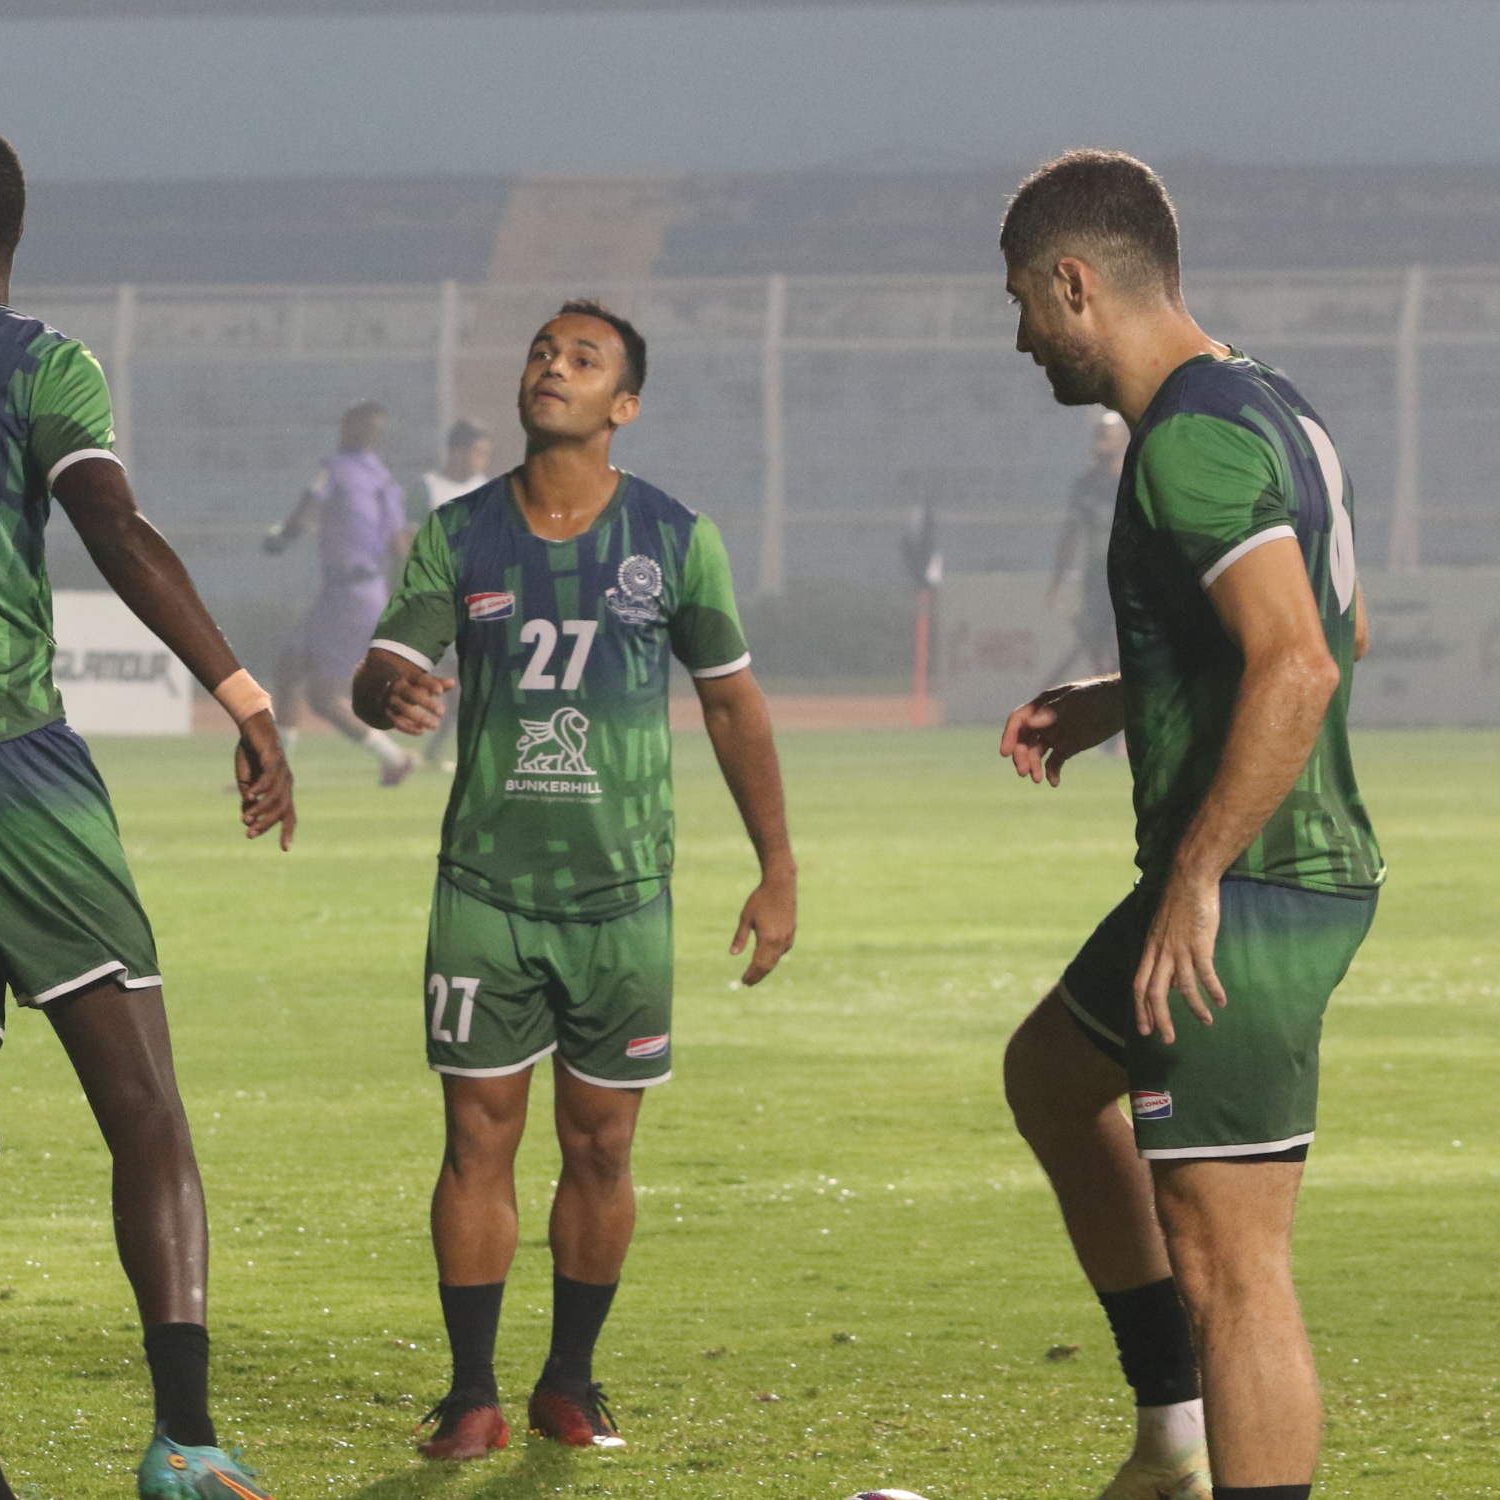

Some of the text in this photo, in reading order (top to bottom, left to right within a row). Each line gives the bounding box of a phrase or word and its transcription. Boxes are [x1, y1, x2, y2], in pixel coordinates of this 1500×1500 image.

[517, 618, 598, 690] 27
[505, 779, 603, 794] BUNKERHILL
[428, 973, 480, 1042] 27
